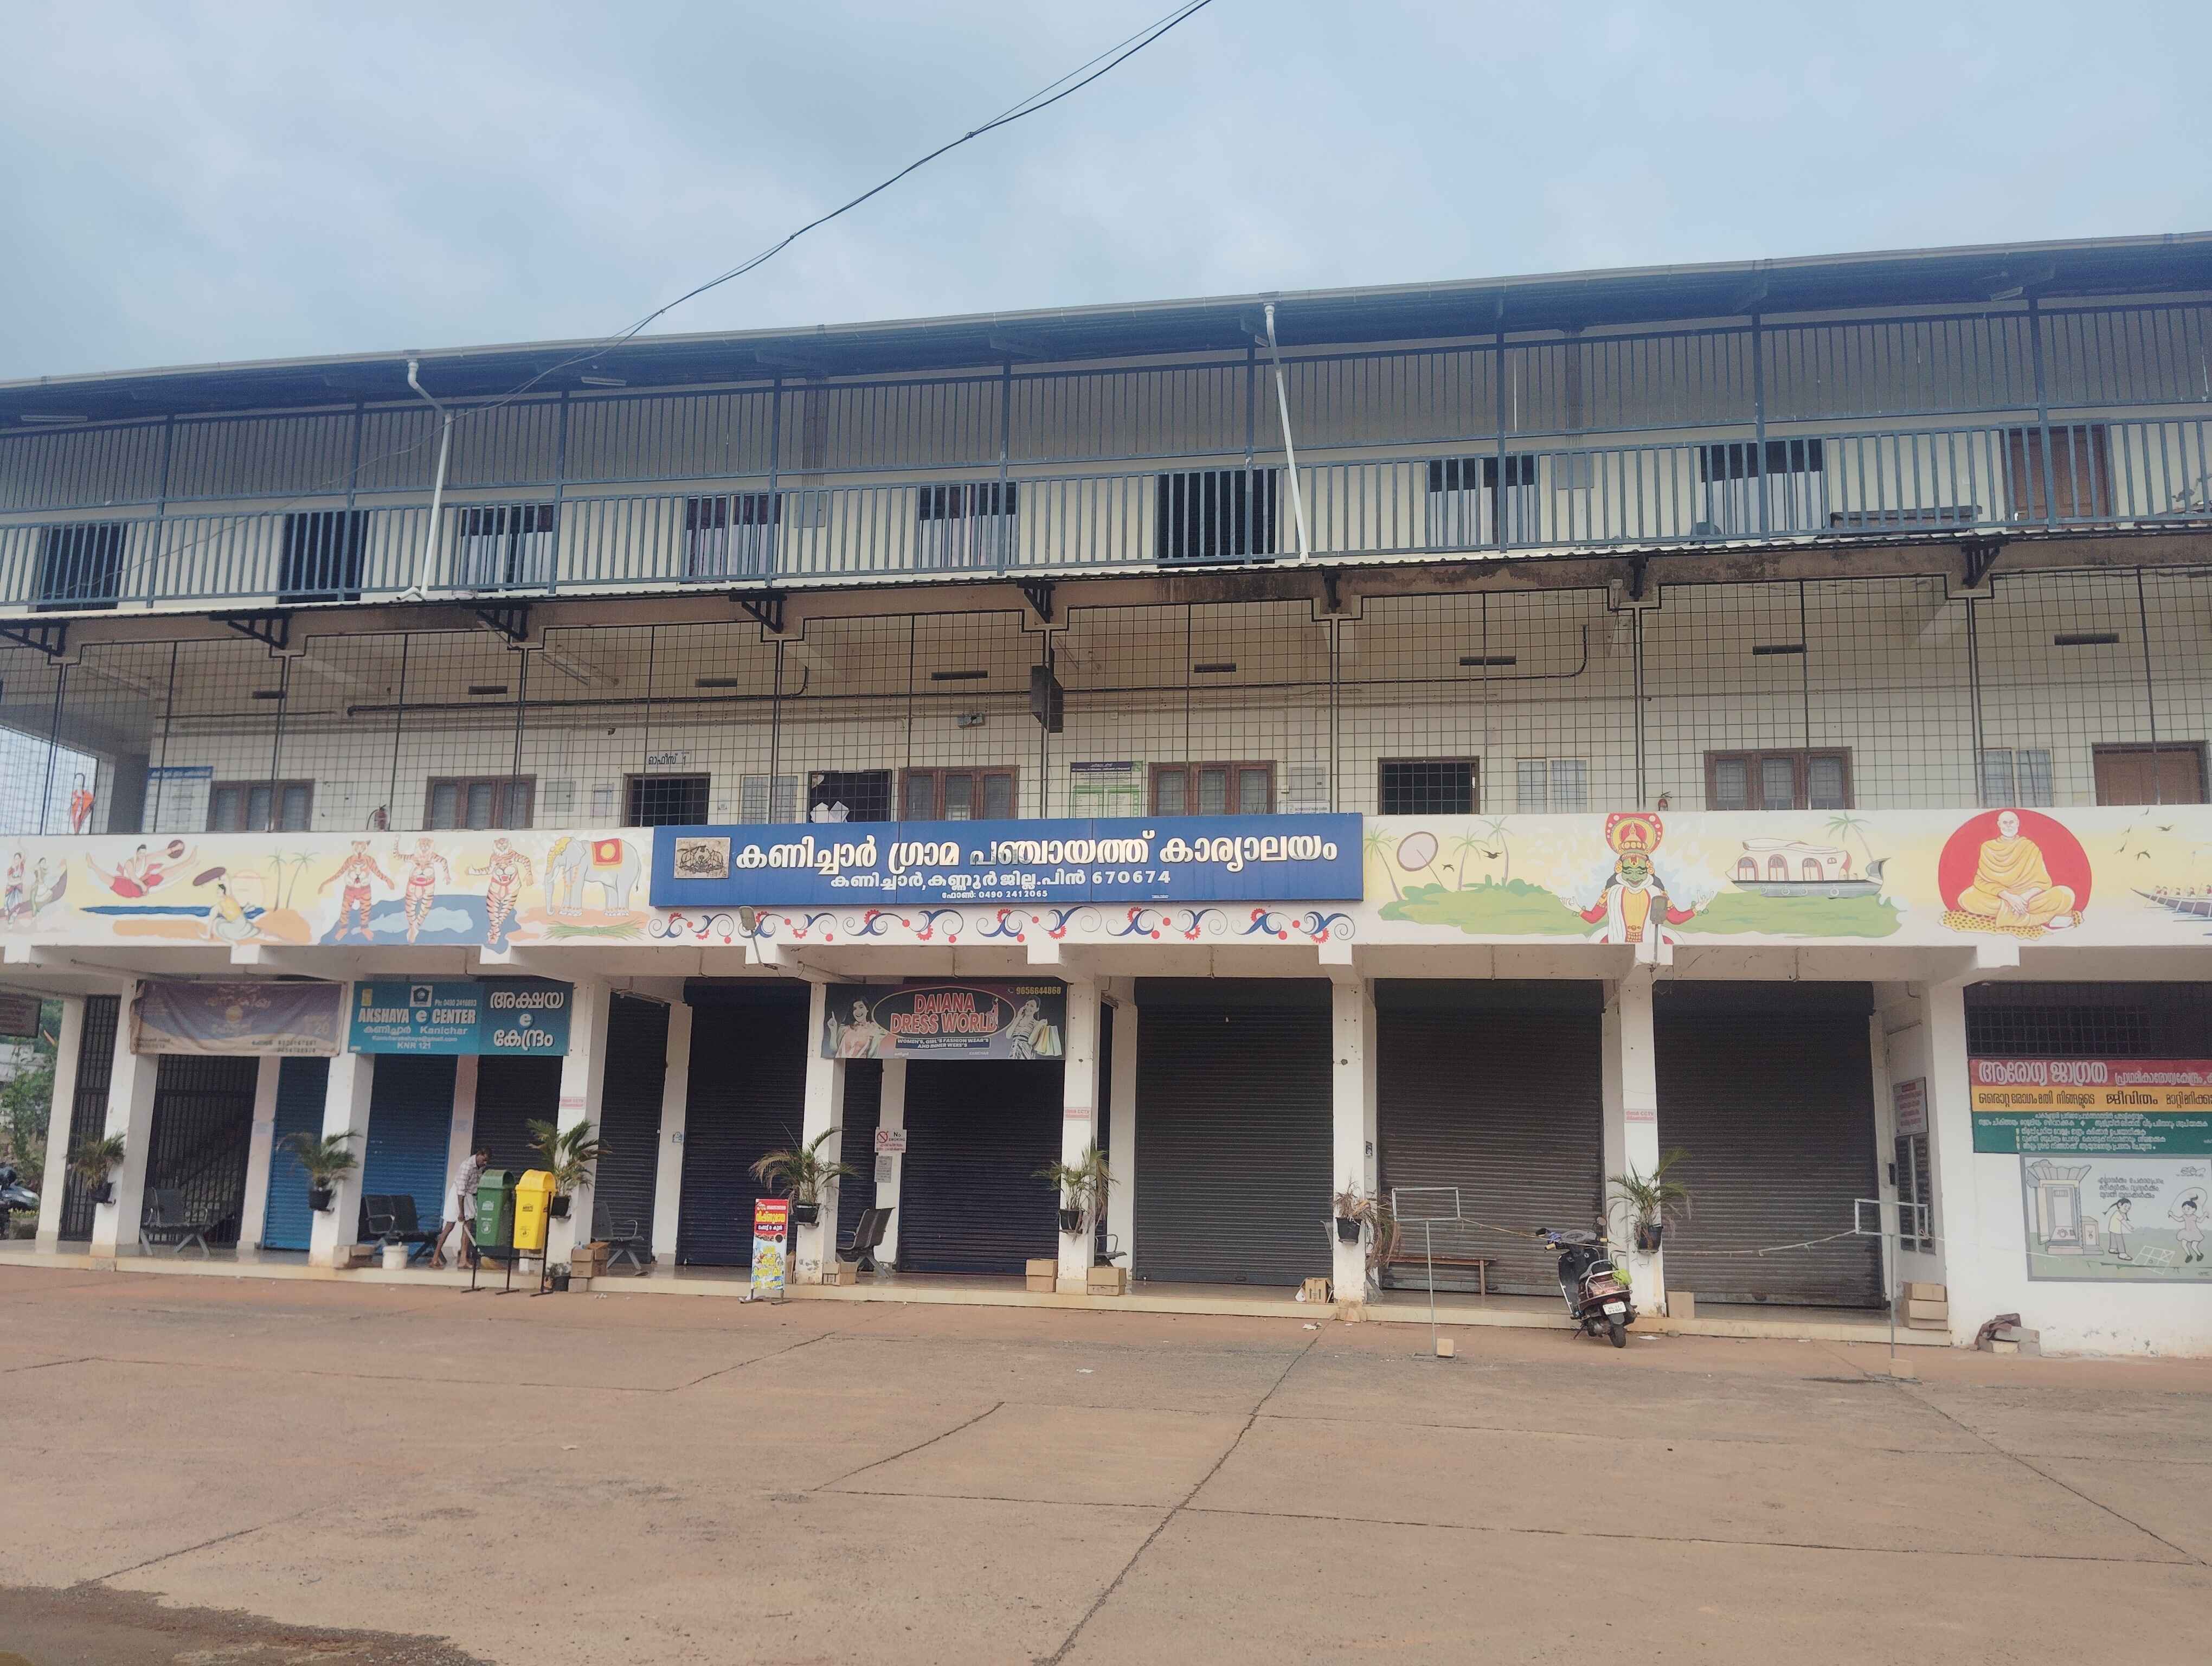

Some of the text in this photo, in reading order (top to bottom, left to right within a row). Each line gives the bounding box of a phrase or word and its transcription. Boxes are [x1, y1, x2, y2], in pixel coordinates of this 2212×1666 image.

[735, 829, 1338, 875] കണിച്ചാർ ഗ്രാമ പഞ്ചായത്ത് കാര്യാലയം
[1092, 870, 1171, 885] 670674
[1006, 890, 1049, 898] 2412065
[490, 992, 564, 1009] അക്ഷയ
[914, 993, 975, 1014] DAIANA
[358, 1008, 476, 1024] AKSHAYA e CENTER
[519, 1014, 532, 1026] e
[890, 1012, 998, 1034] DRESS WORLD
[420, 1026, 468, 1035] Kanichar
[494, 1029, 554, 1050] കേന്ദ്രം
[1979, 1061, 2047, 1086] ആരോഗ്യ
[2050, 1061, 2108, 1086] ജാഗ്രത
[2106, 1090, 2158, 1105] ജീവിതം
